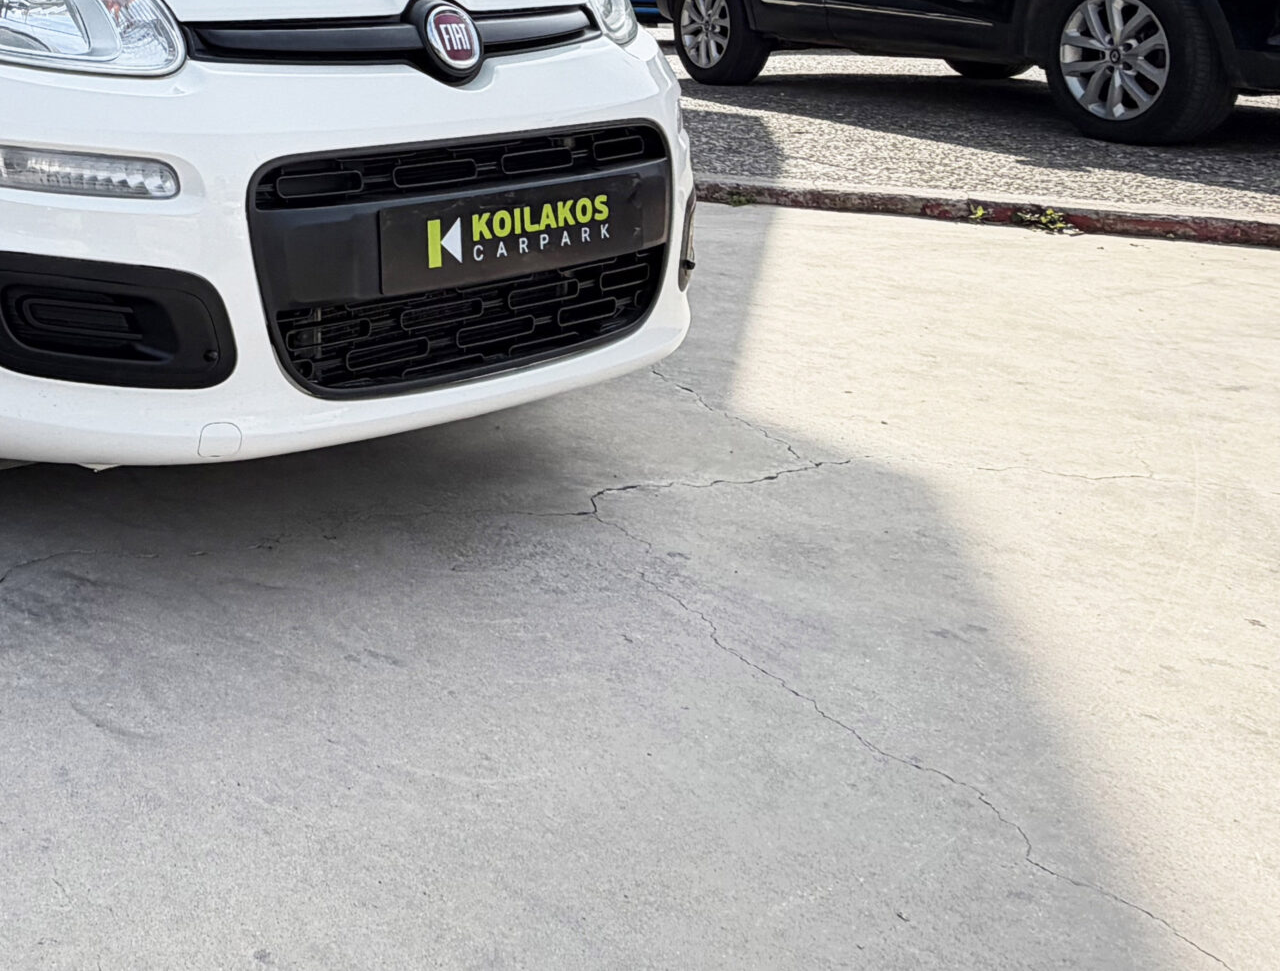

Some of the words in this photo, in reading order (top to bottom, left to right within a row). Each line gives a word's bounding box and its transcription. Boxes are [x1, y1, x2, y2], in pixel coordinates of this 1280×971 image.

[439, 23, 471, 51] FIAT
[472, 195, 609, 241] KOILAKOS
[473, 224, 610, 261] CARPARK
